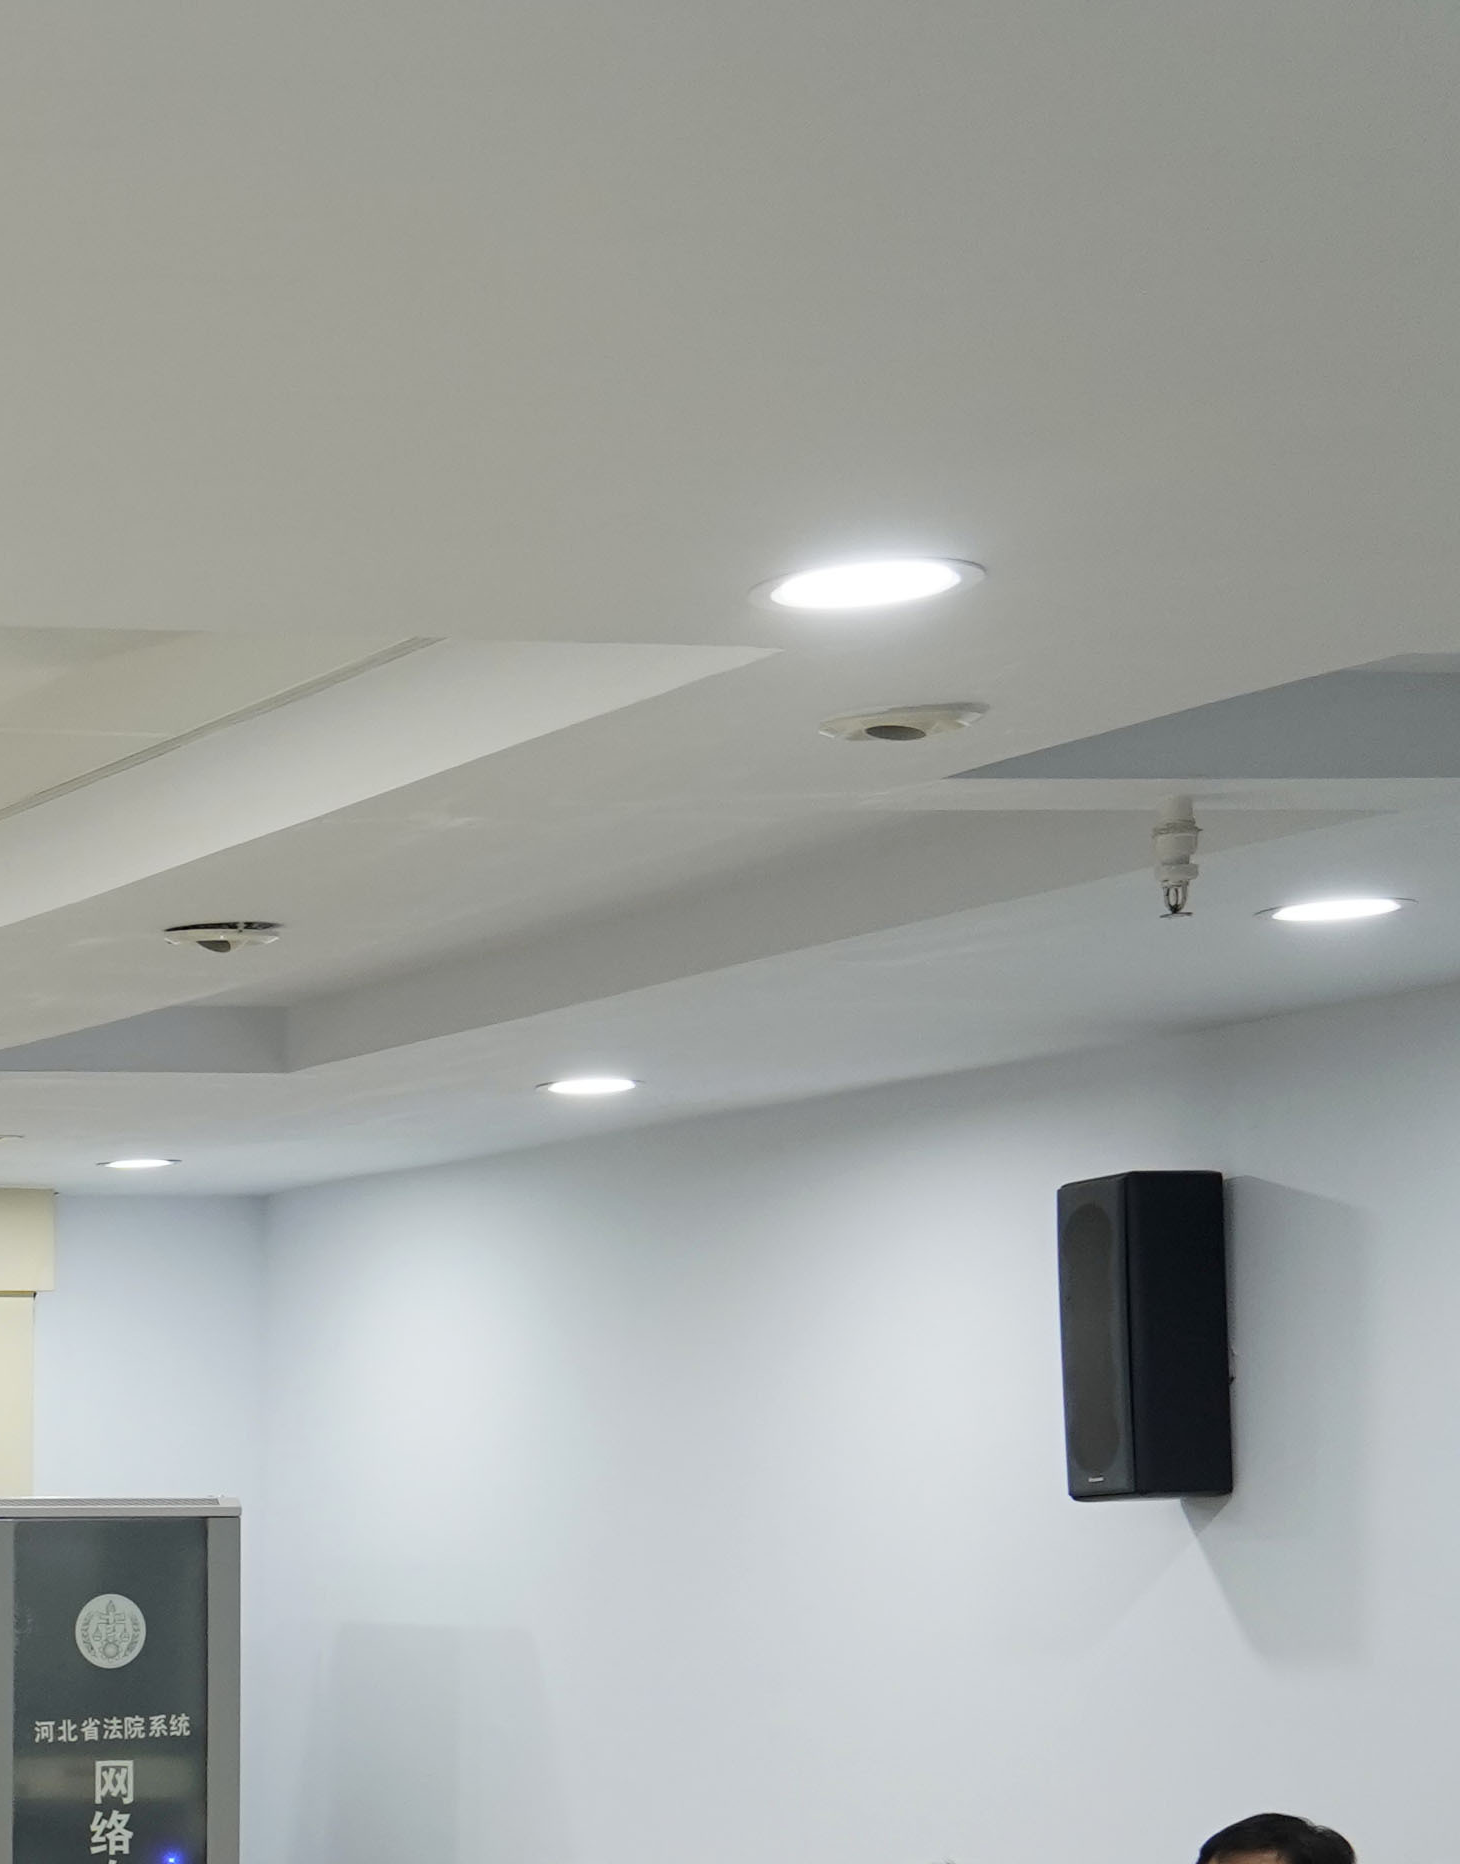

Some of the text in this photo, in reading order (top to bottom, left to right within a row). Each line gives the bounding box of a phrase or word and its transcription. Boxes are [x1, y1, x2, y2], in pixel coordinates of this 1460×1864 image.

[34, 1712, 192, 1743] 河北省法院系统
